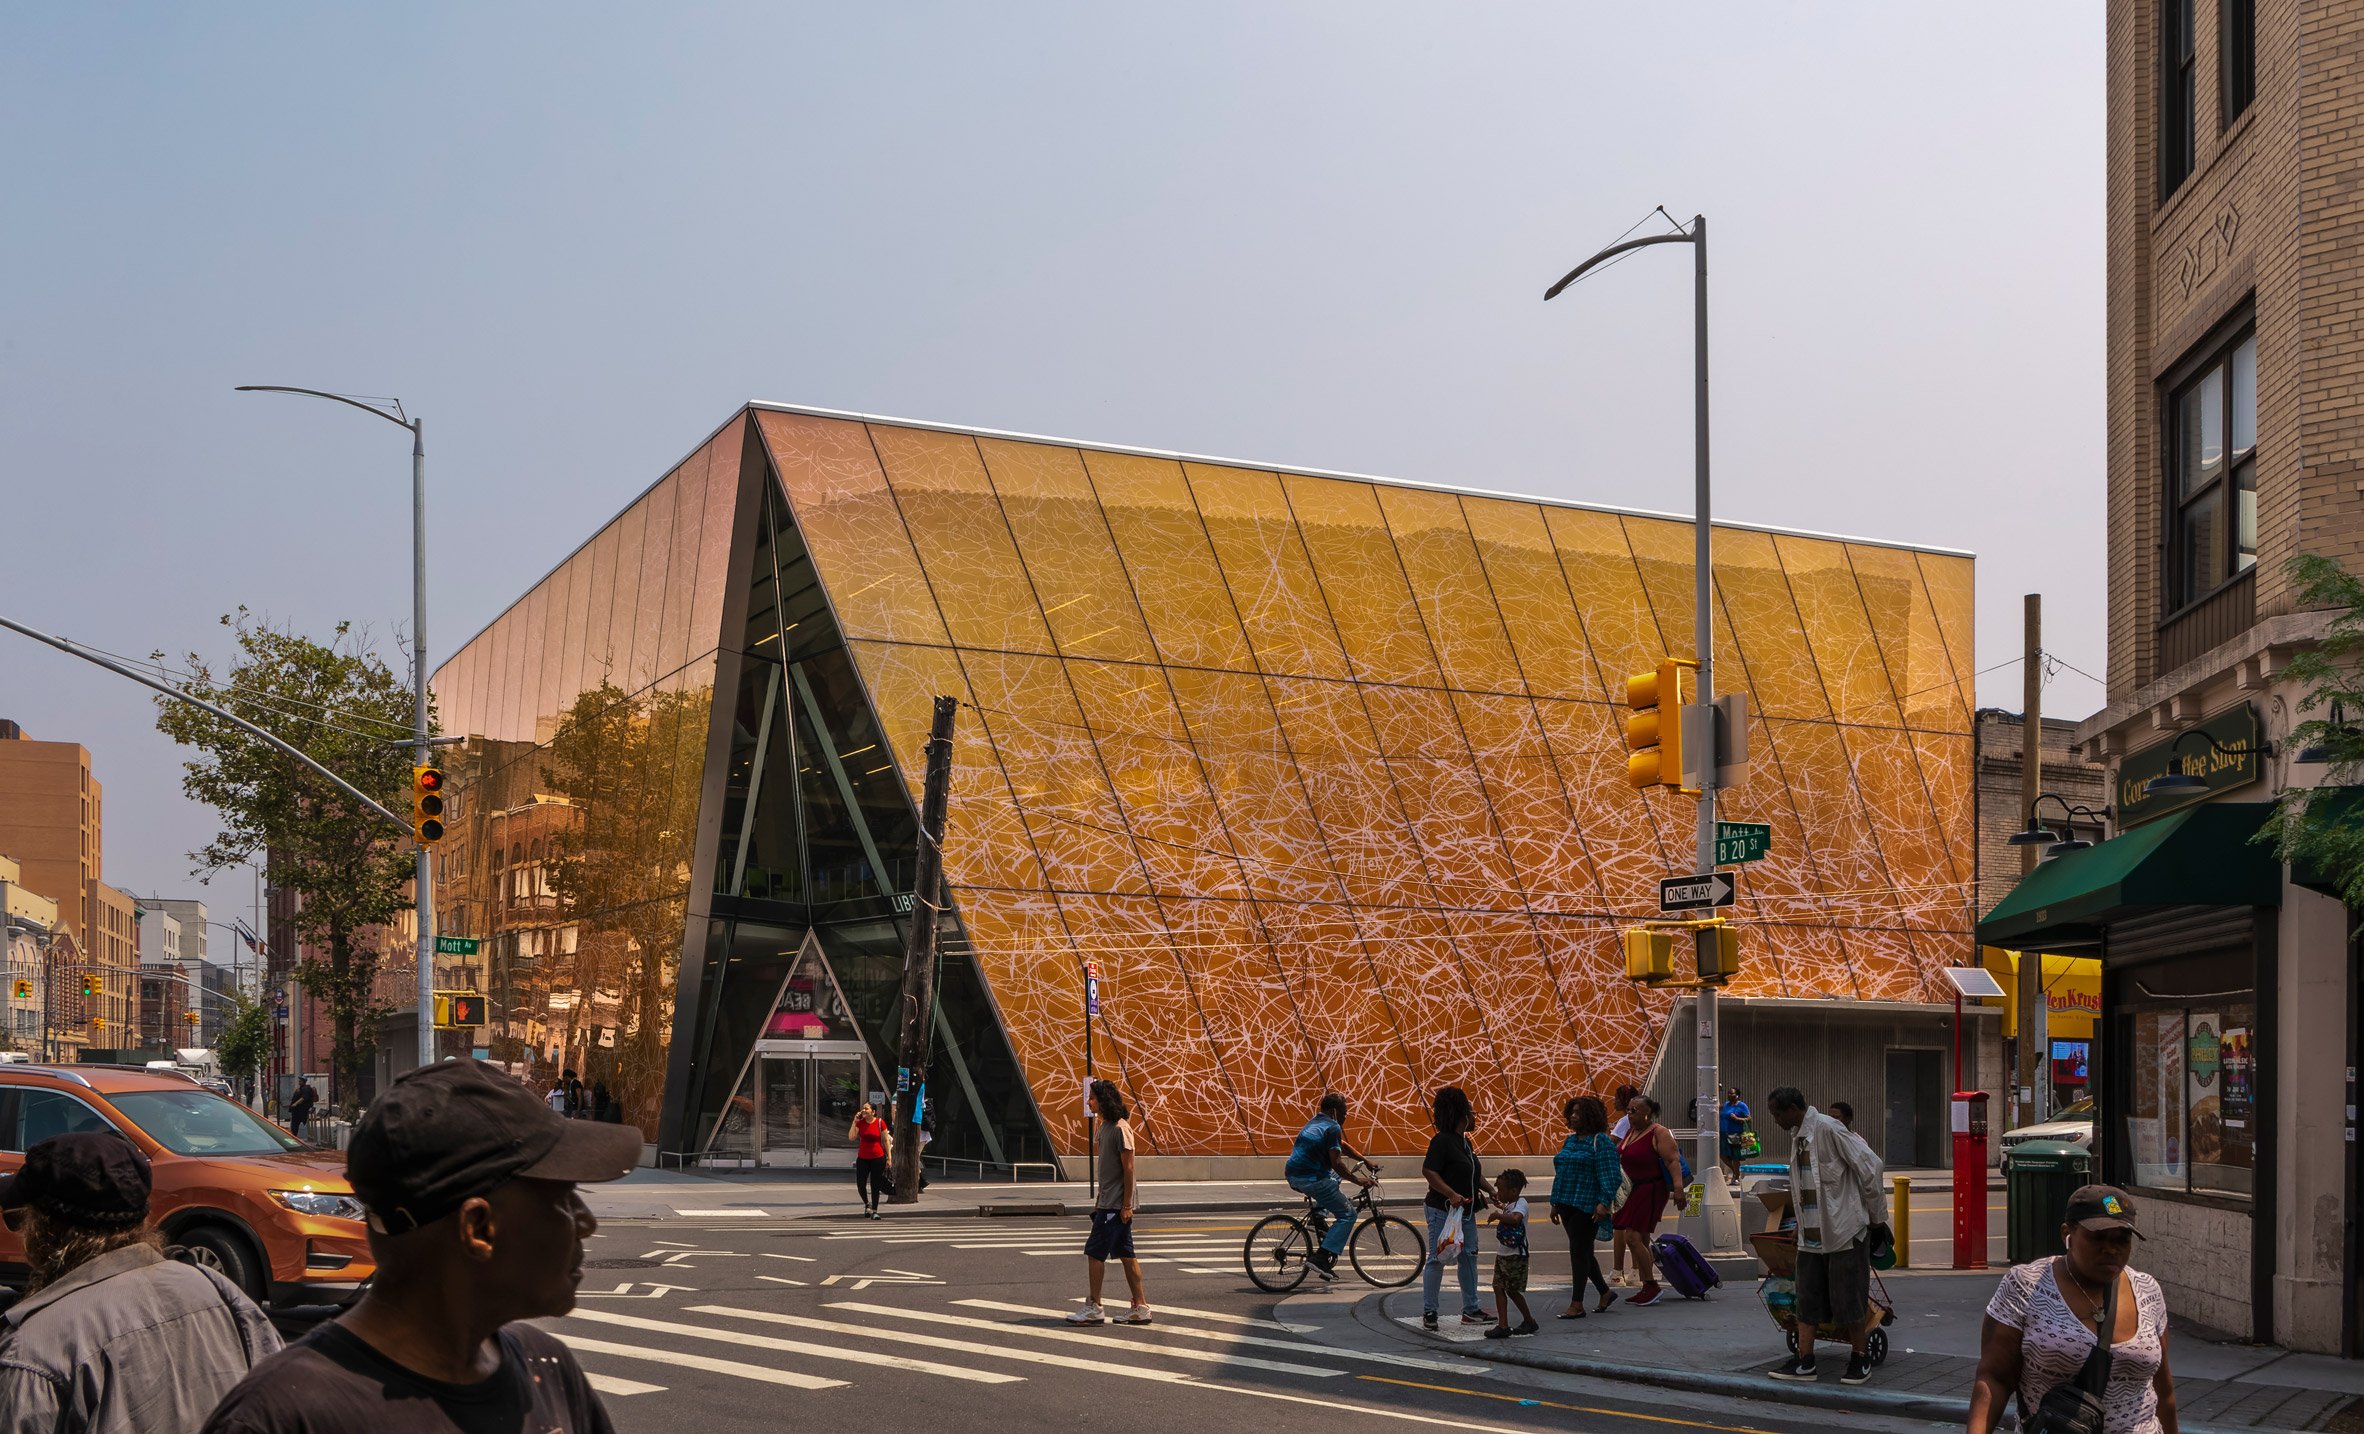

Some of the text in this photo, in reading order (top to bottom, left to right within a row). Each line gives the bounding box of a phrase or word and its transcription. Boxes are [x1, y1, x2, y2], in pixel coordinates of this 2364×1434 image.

[2210, 738, 2247, 772] Shop
[1720, 838, 1758, 862] B 20 St
[1668, 885, 1712, 901] ONE WAY
[440, 939, 472, 952] Mott Av
